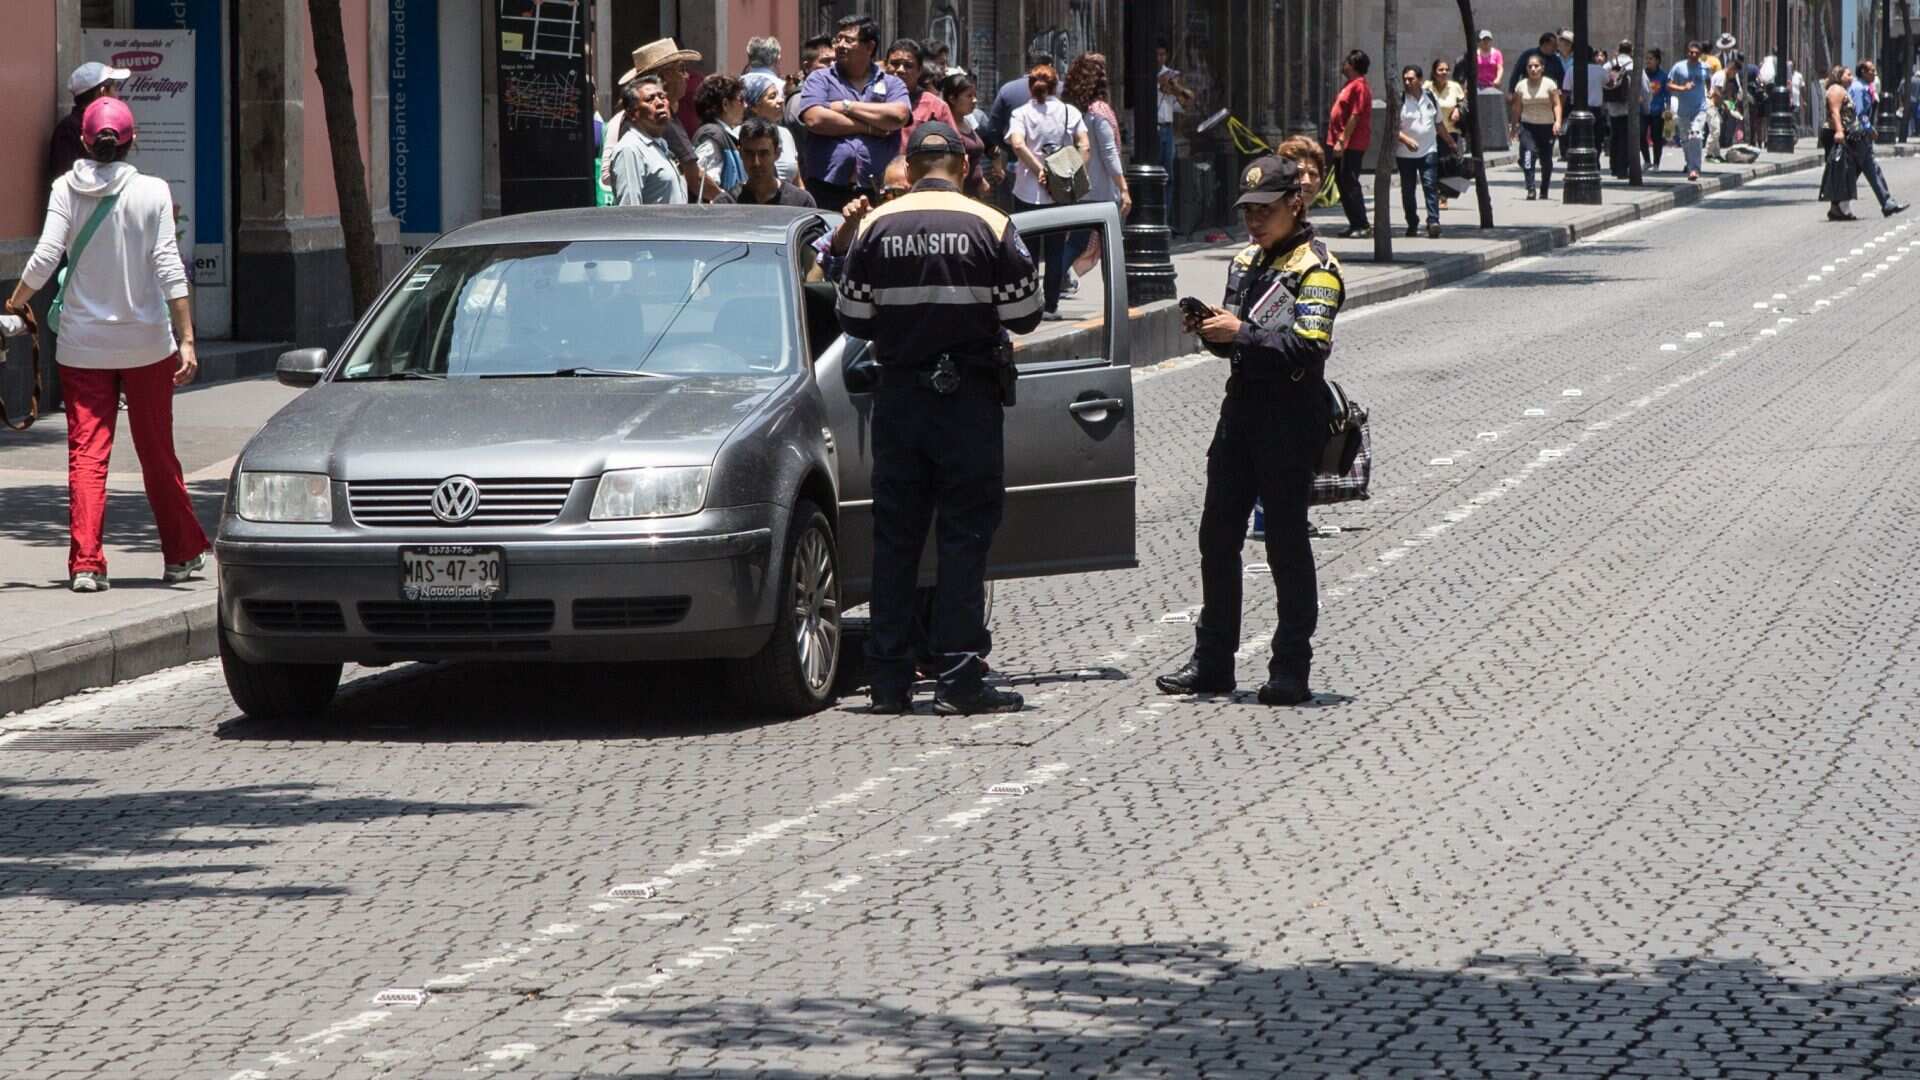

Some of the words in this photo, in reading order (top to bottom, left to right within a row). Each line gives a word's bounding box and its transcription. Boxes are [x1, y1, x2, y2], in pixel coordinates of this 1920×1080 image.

[391, 0, 406, 79] Encuade
[115, 55, 160, 68] NUEVO
[392, 92, 409, 224] Autocopiante
[881, 232, 970, 258] TRANSITO
[403, 559, 499, 583] MAS-47-30
